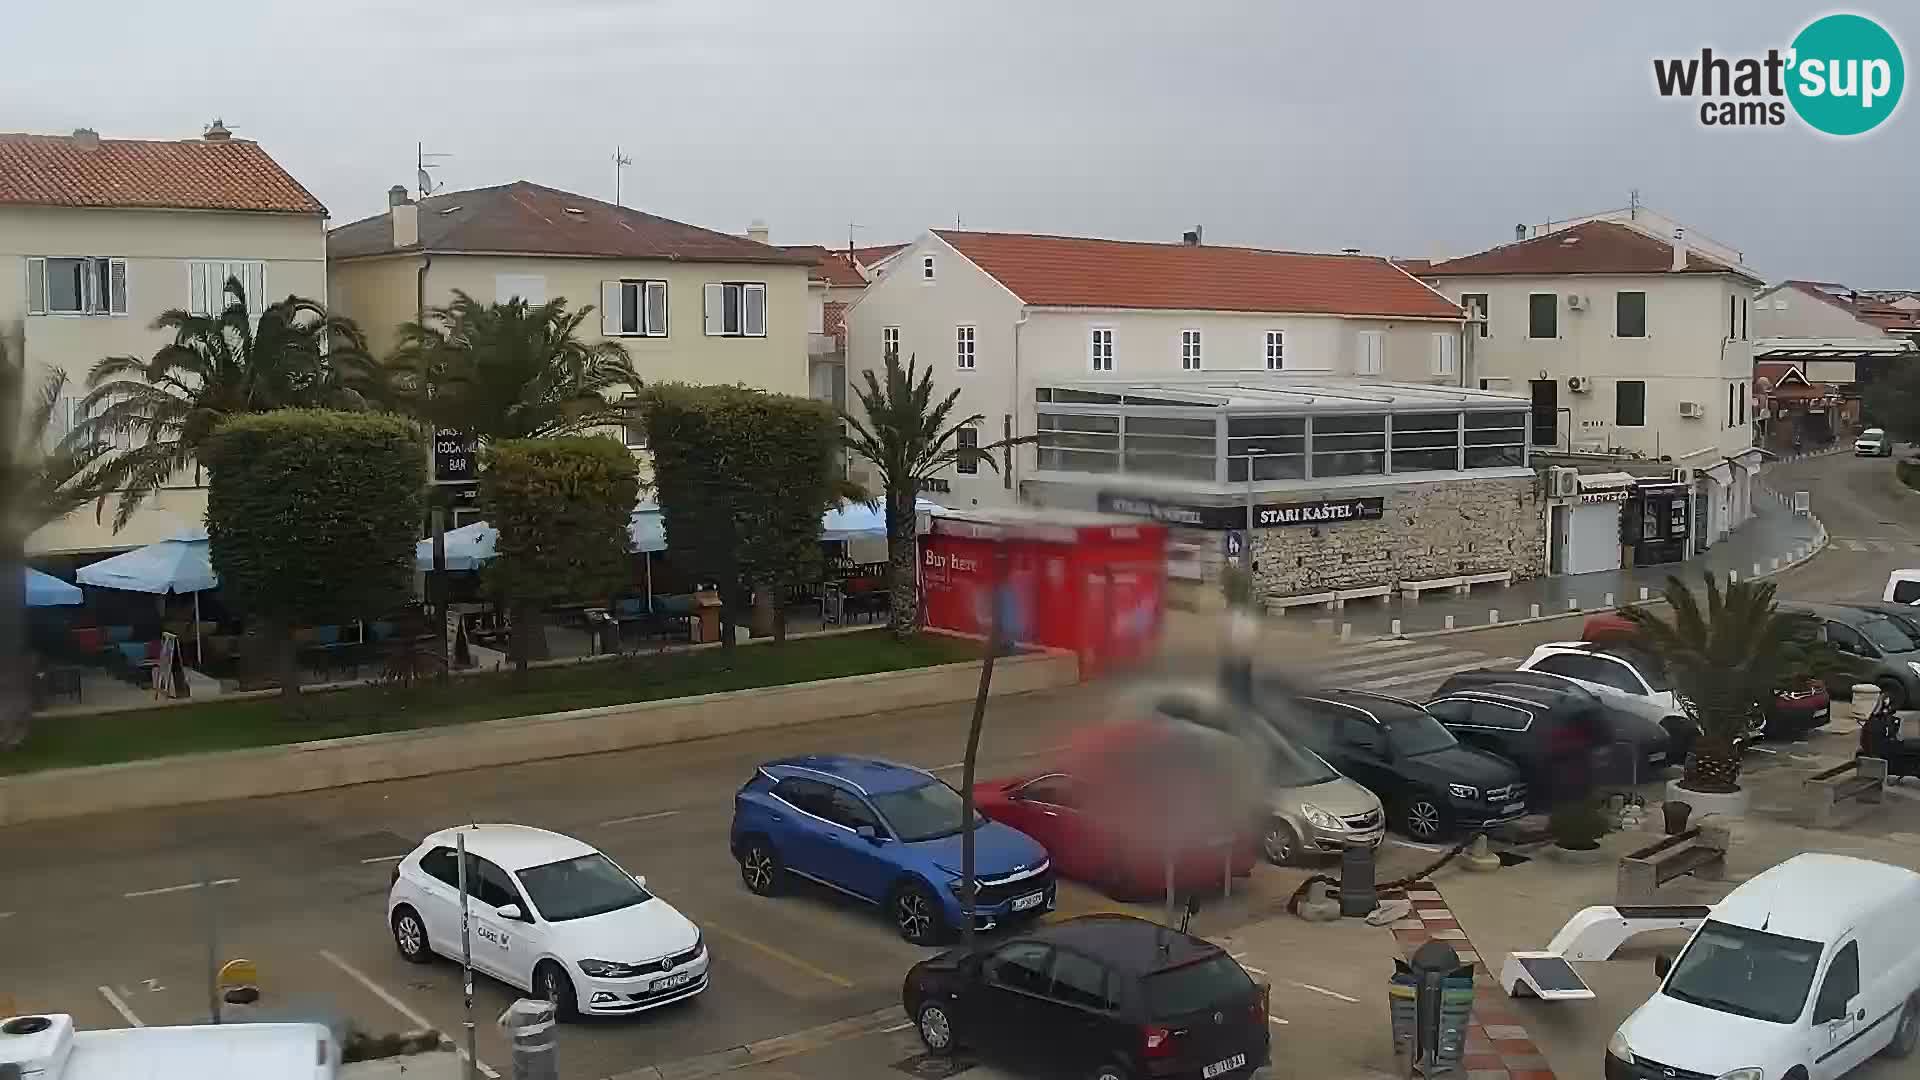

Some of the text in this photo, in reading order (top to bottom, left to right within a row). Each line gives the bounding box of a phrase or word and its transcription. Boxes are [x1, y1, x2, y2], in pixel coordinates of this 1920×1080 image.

[449, 458, 466, 471] BAR
[1260, 507, 1300, 525] STARI
[1302, 502, 1353, 521] KAŠTEL
[925, 549, 946, 568] Buy
